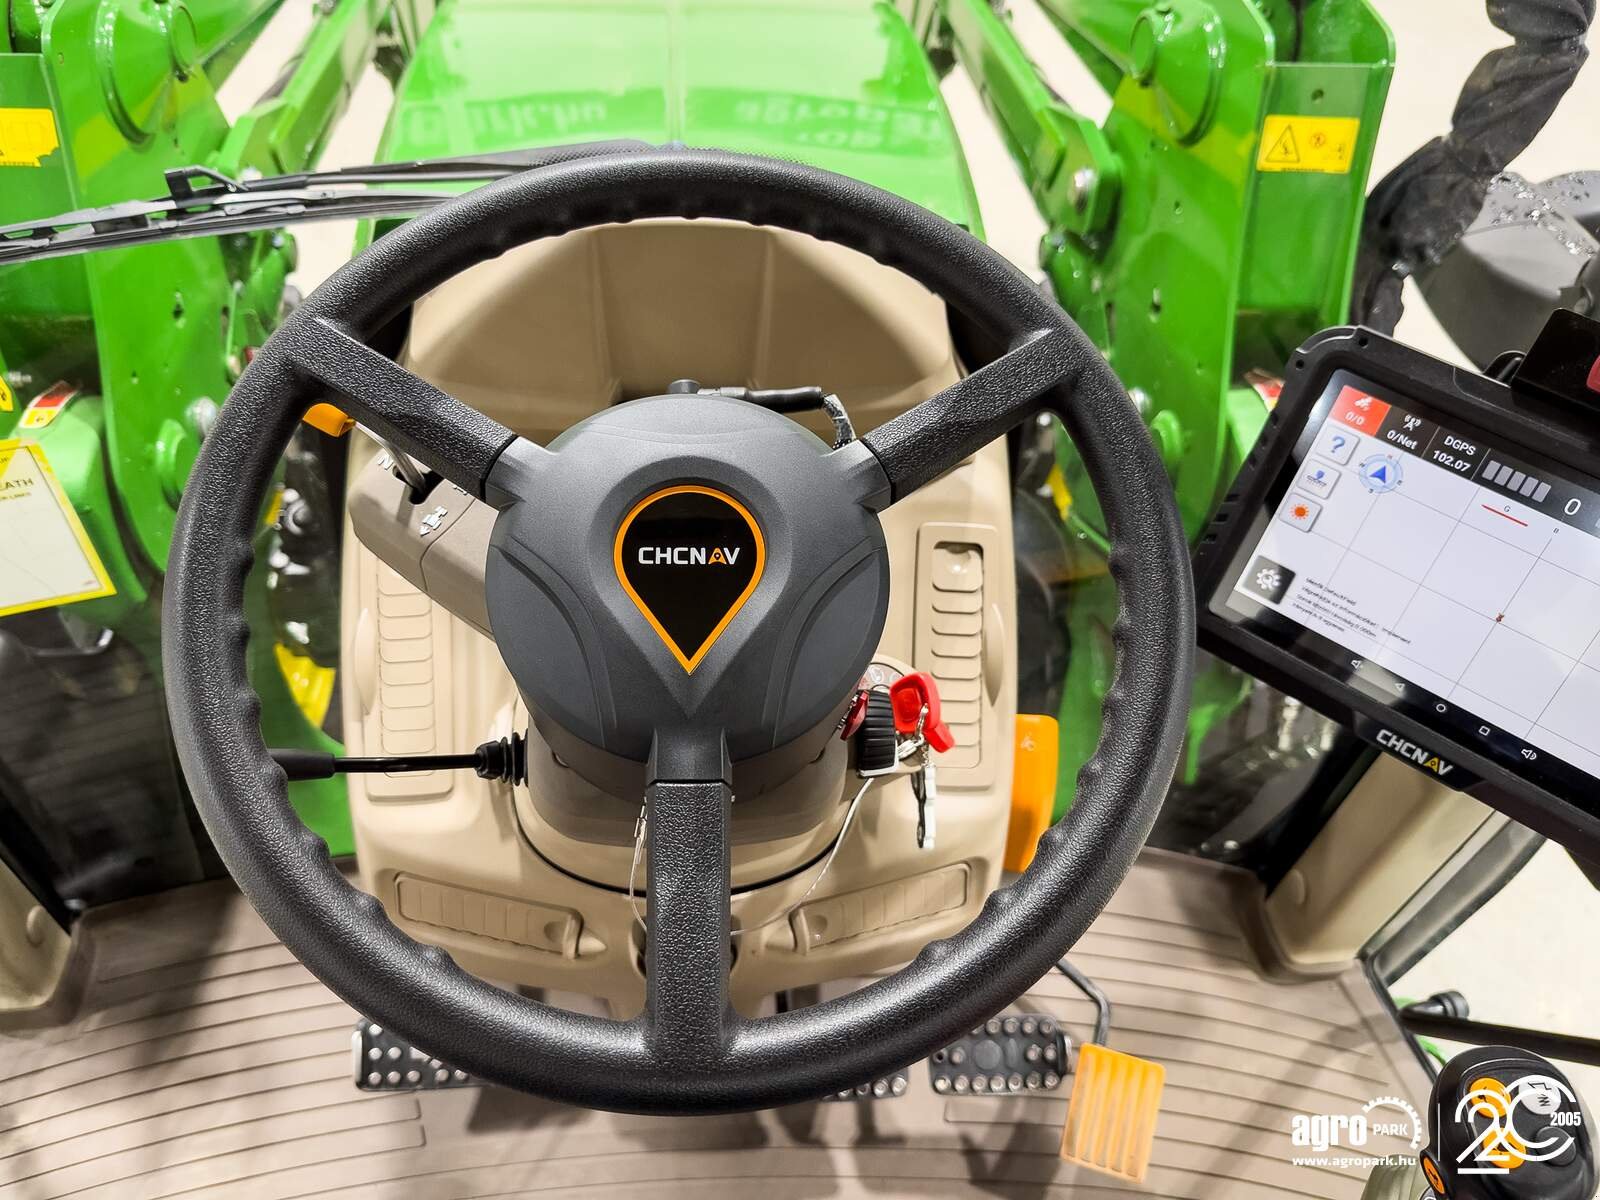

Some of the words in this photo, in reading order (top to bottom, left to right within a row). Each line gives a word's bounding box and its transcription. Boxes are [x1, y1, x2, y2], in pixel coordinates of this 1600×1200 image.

[1386, 430, 1418, 450] 0/Net
[1443, 435, 1477, 456] DGPS
[1432, 450, 1471, 472] 102.07
[1564, 498, 1582, 515] 0
[638, 547, 740, 565] CHCNAV
[1376, 729, 1454, 775] CHCNAV
